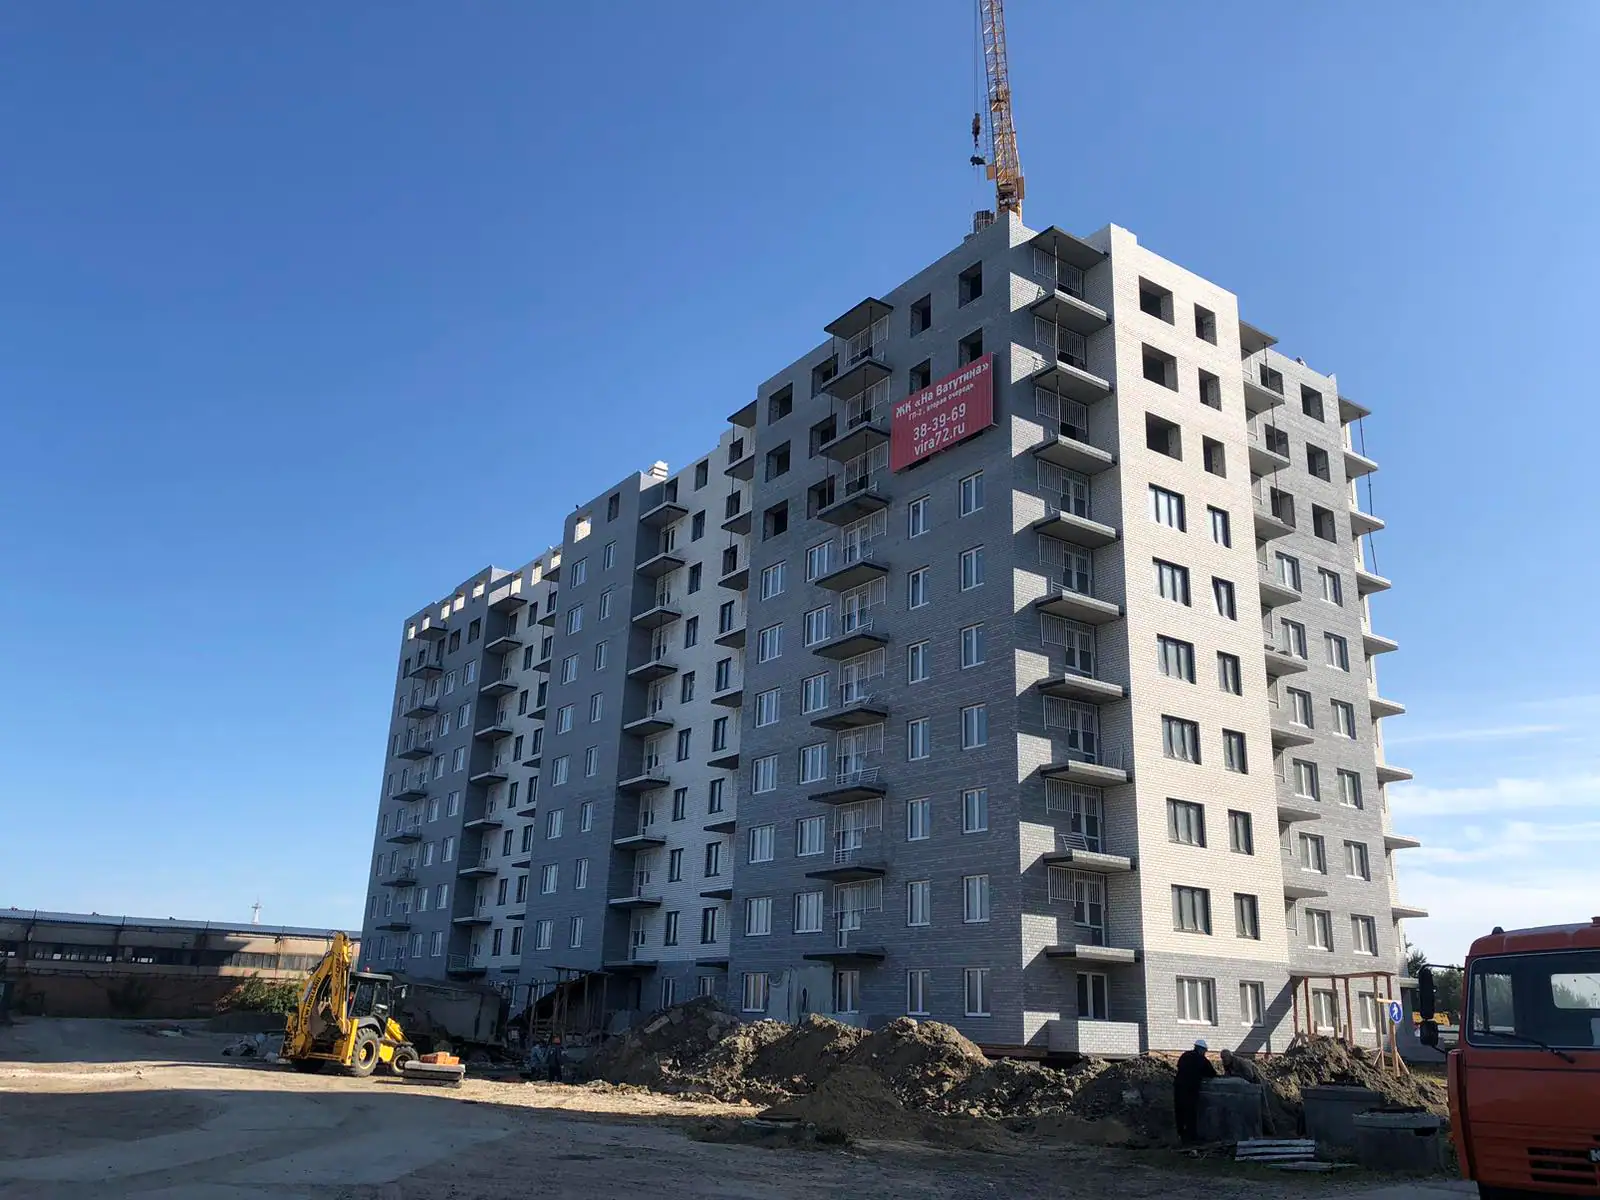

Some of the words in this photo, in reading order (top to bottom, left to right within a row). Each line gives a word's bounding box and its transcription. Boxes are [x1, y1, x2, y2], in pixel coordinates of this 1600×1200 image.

[896, 401, 911, 418] ЖК
[914, 391, 933, 408] «На
[936, 363, 989, 396] Ватутина»
[948, 383, 974, 400] очередь
[913, 403, 966, 440] 38-39-69
[914, 422, 965, 456] vira72.ru
